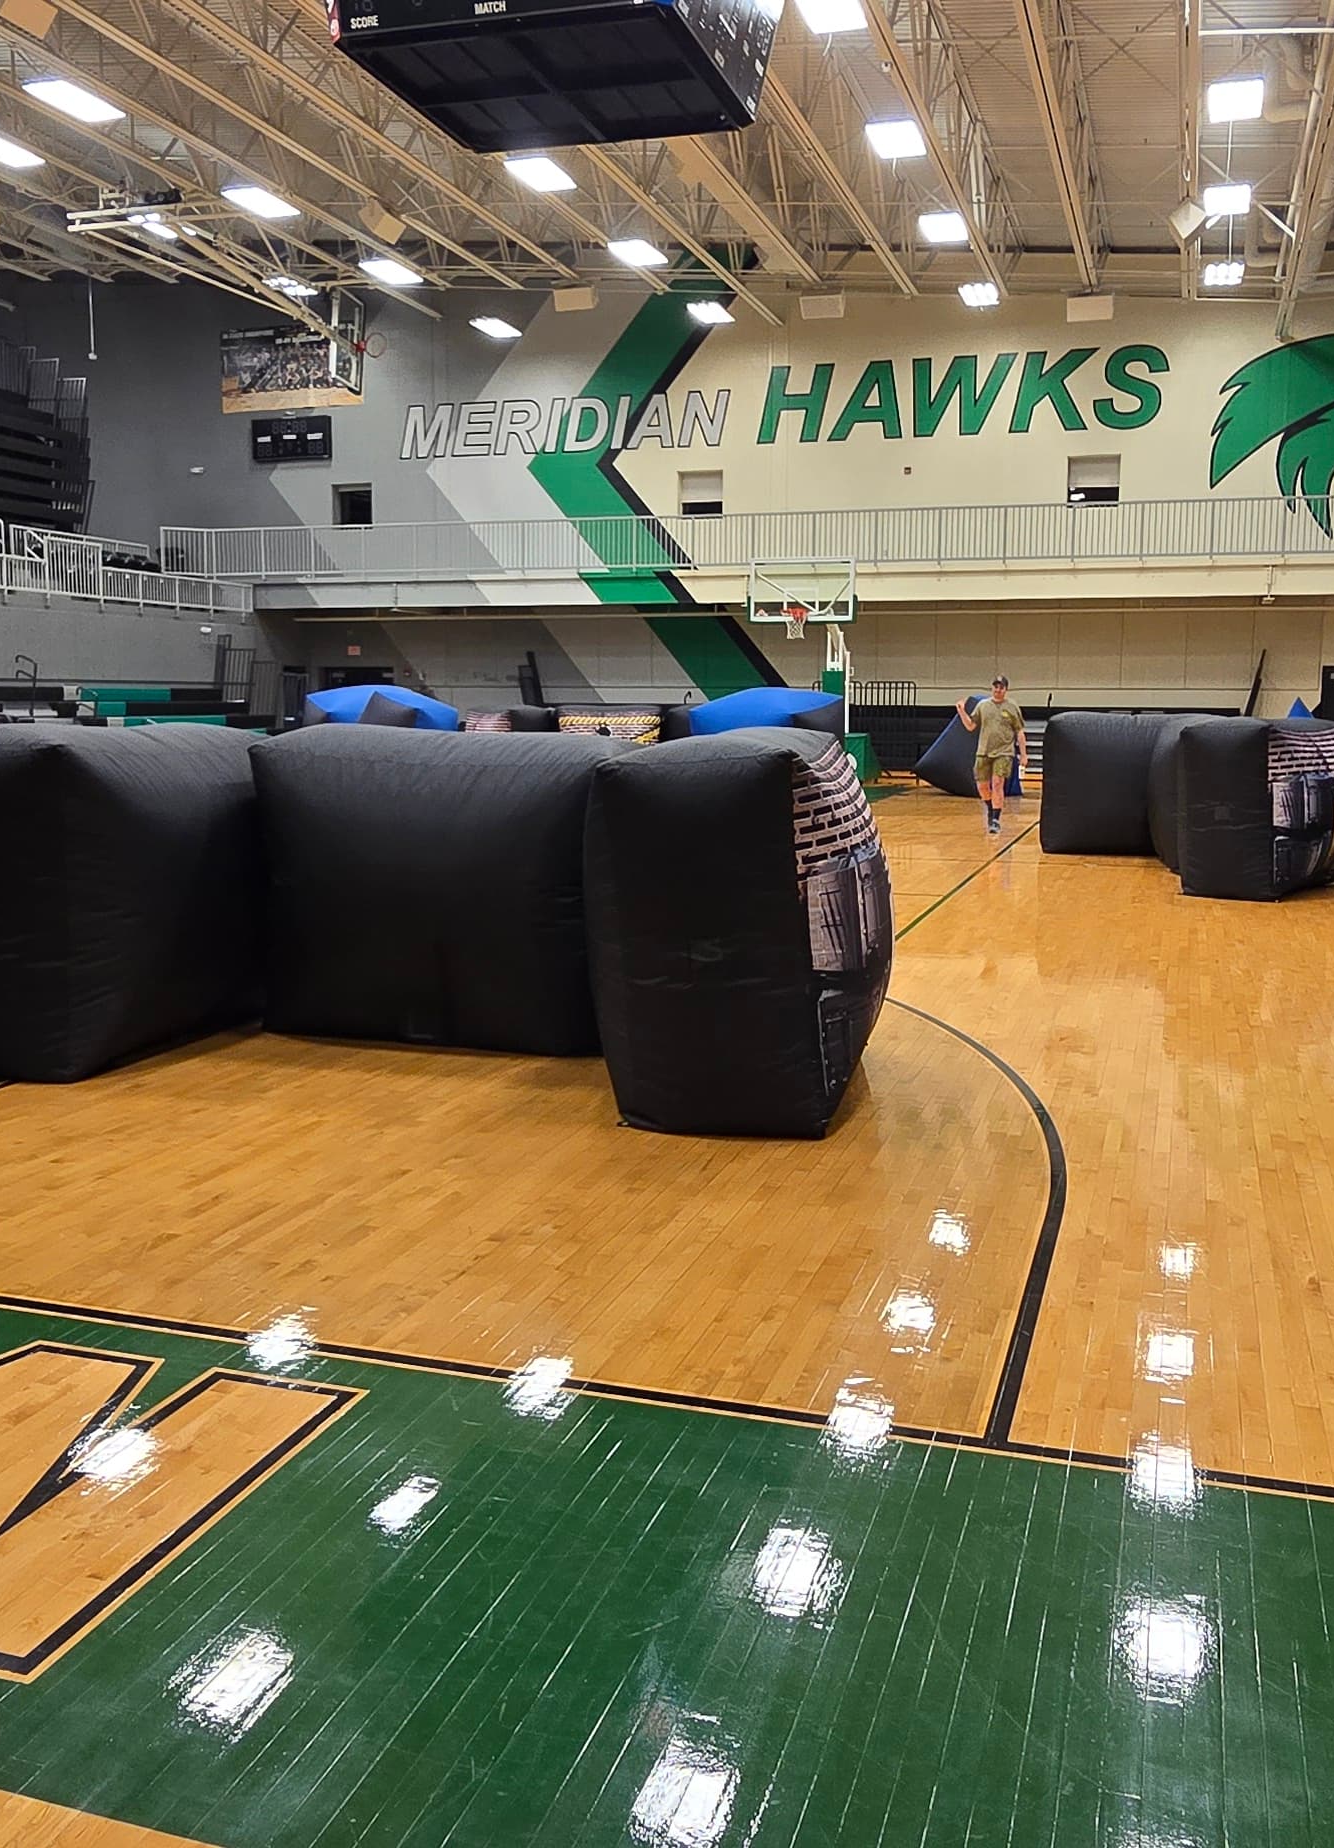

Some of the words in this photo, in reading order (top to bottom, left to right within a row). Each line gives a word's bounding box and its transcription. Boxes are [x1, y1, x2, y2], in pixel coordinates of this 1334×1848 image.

[474, 0, 507, 15] MATCH
[350, 15, 379, 29] SCORE
[399, 388, 730, 460] MERIDIAN
[756, 344, 1170, 445] HAWKS
